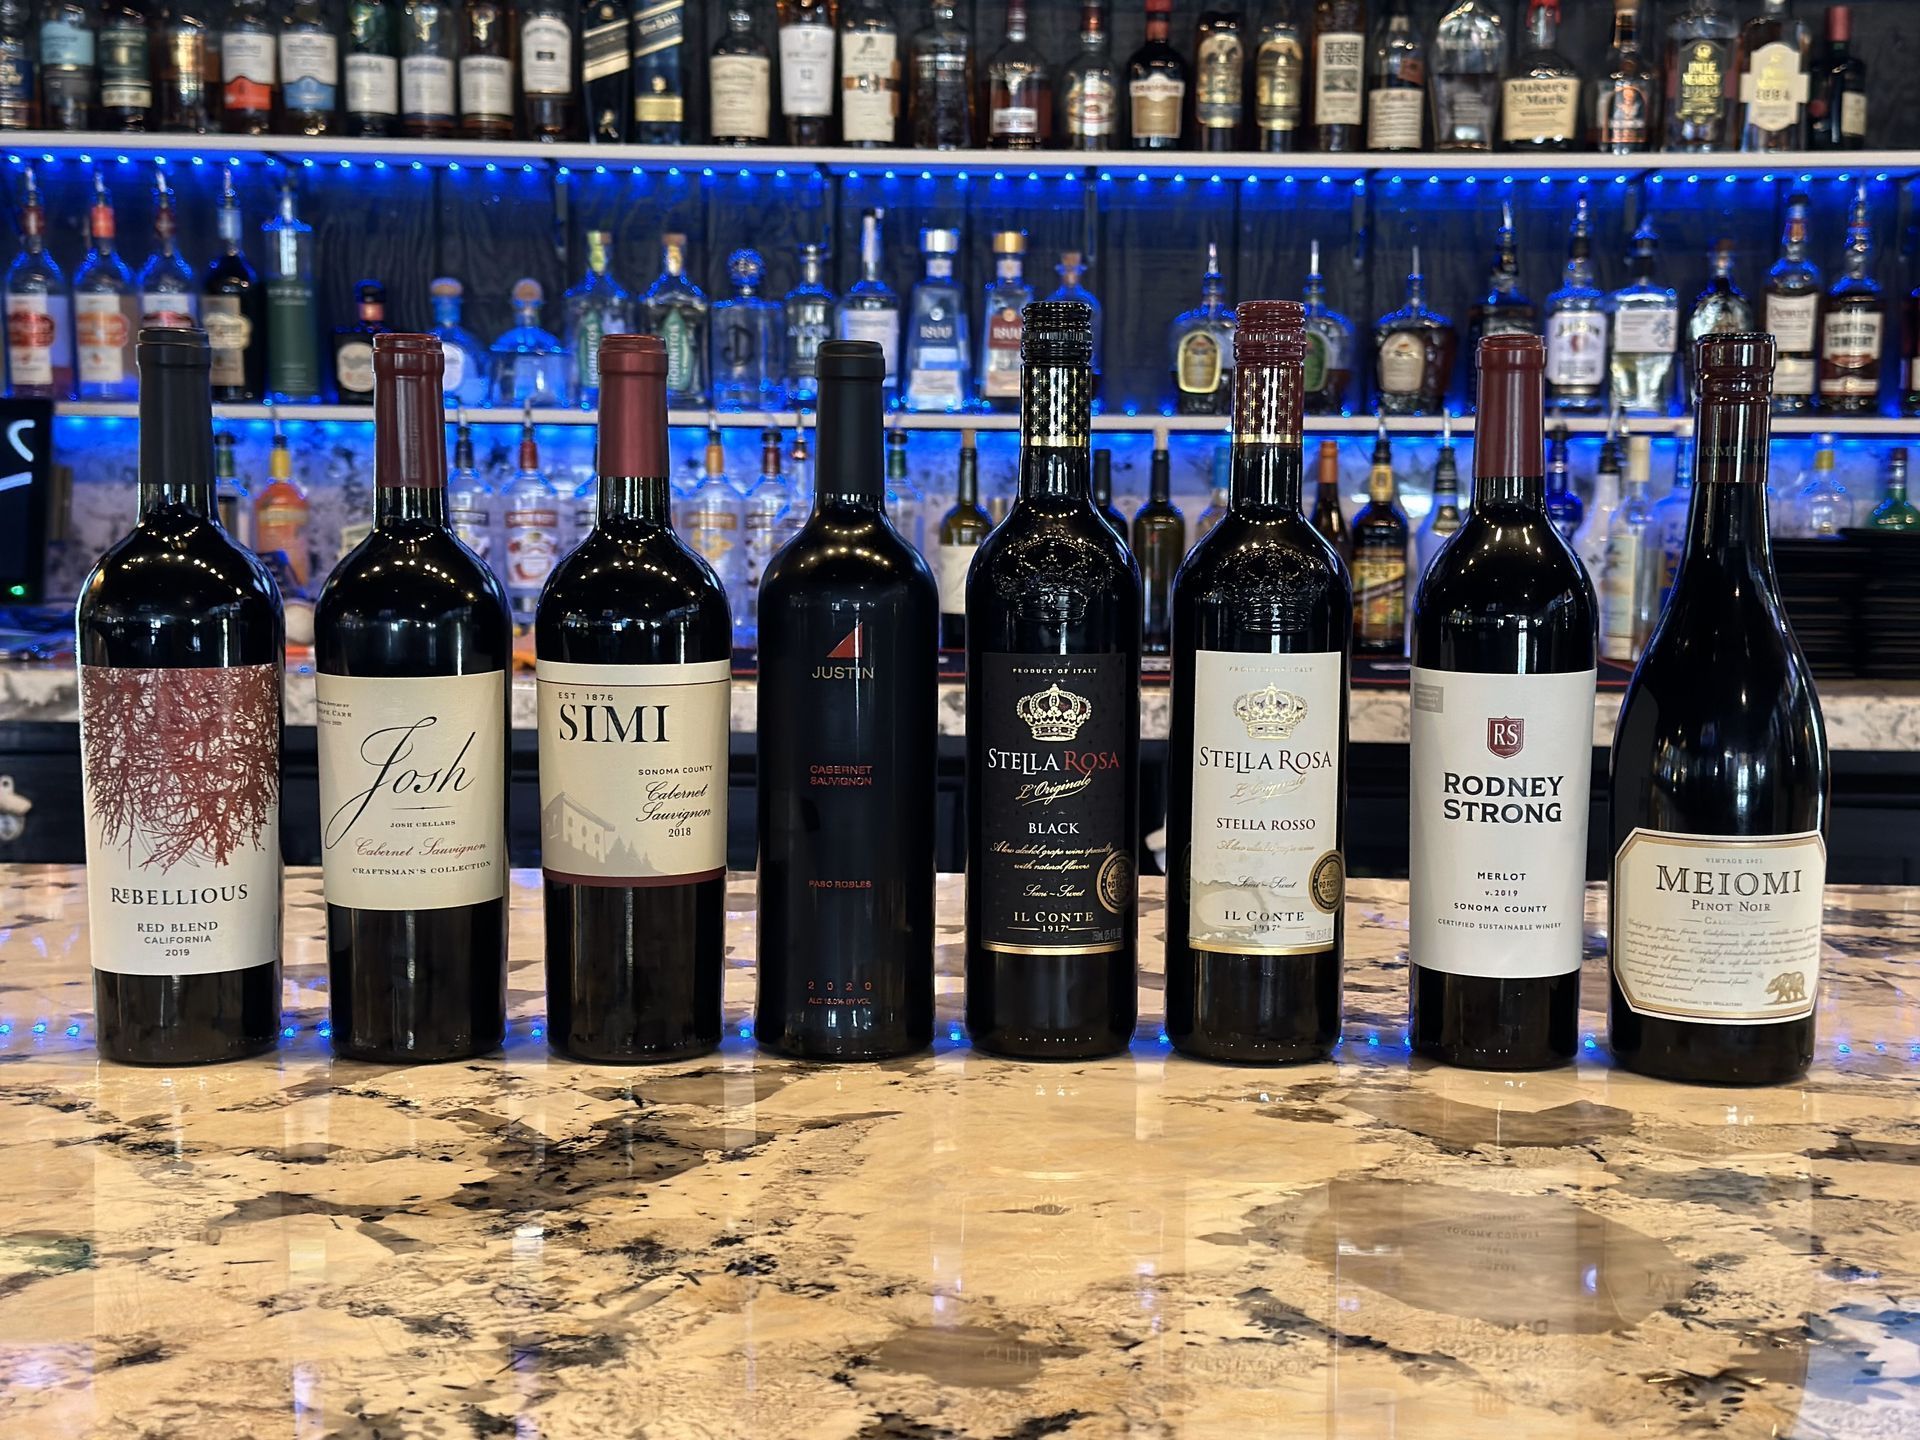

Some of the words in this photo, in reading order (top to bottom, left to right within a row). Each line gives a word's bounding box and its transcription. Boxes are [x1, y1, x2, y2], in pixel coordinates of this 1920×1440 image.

[812, 666, 875, 680] JUSTIN
[558, 691, 576, 700] EST
[586, 693, 614, 701] 1876
[559, 703, 670, 743] SIMI
[1494, 723, 1519, 746] RS
[988, 748, 1060, 775] STELLA
[1063, 750, 1120, 775] ROSA
[1199, 746, 1274, 774] STELLA
[1279, 750, 1332, 775] ROSA
[638, 768, 680, 776] SONOMA
[683, 765, 713, 774] COUNTY
[809, 765, 873, 775] CABERNET
[325, 716, 476, 849] Josh
[809, 776, 873, 786] SAUVIGNON
[1015, 769, 1091, 805] L'Originale
[1443, 772, 1564, 798] RODNEY
[645, 781, 709, 801] Cabernet
[635, 802, 712, 828] Sauvignon
[1443, 798, 1563, 824] STRONG
[390, 821, 413, 829] JOSH
[415, 819, 456, 828] CELLARS
[1028, 822, 1079, 835] BLACK
[1216, 817, 1266, 831] STELLA
[1271, 818, 1316, 831] ROSSO
[668, 827, 692, 838] 2018
[355, 837, 413, 857] Cabernet
[419, 836, 487, 859] Sauvignon
[352, 866, 427, 876] CRAFTSMAN'S
[430, 861, 491, 874] COLLECTION
[1477, 871, 1527, 881] MERLOT
[1655, 864, 1802, 897] MEIOMI
[111, 883, 249, 906] REBELLIOUS
[1485, 889, 1518, 897] v.2019
[1454, 902, 1499, 913] SONOMA
[1504, 904, 1548, 913] COUNTY
[1691, 899, 1733, 912] PINOT
[1738, 901, 1771, 912] NOIR
[1014, 911, 1029, 922] IL
[1035, 911, 1094, 924] CONTE
[1224, 911, 1240, 921] IL
[1246, 911, 1305, 922] CONTE
[137, 922, 164, 934] RED
[171, 920, 218, 933] BLEND
[1042, 924, 1066, 932] 1917
[1437, 918, 1475, 928] CERTIFIED
[1535, 921, 1562, 930] WINERY
[144, 934, 212, 944] CALIFORNIA
[165, 948, 190, 957] 2019
